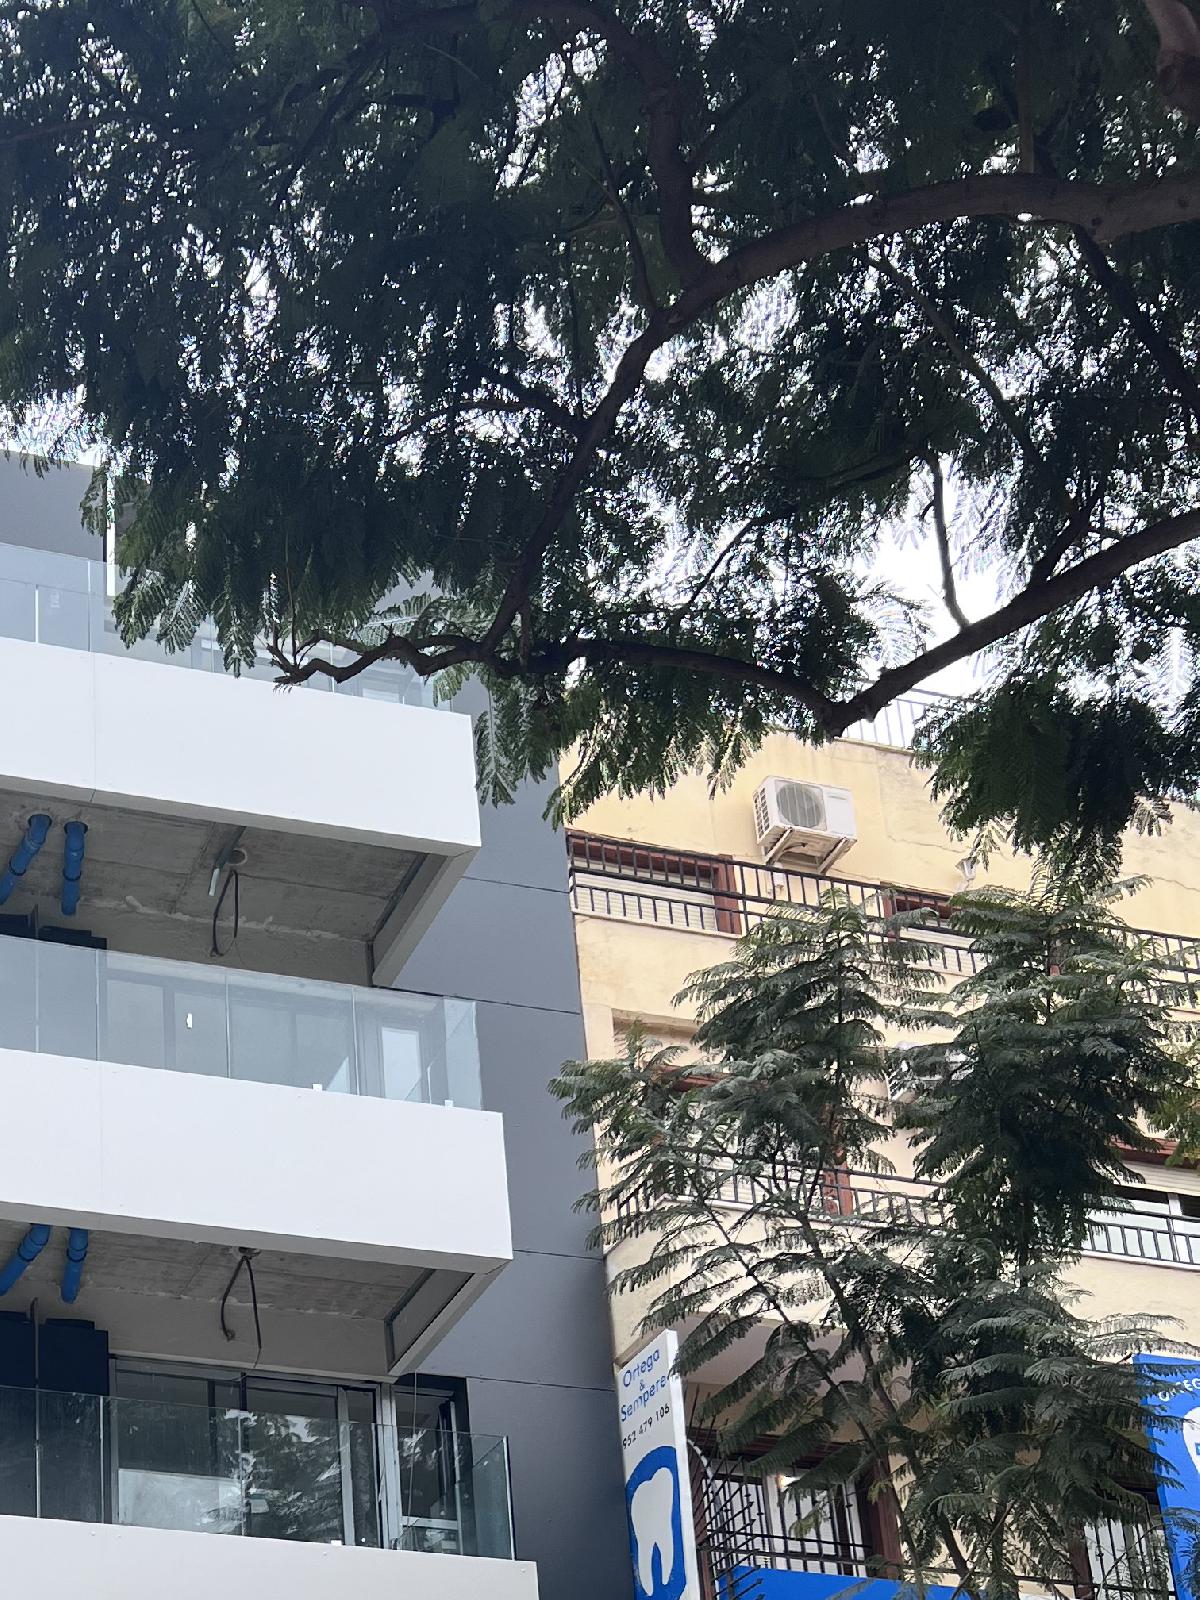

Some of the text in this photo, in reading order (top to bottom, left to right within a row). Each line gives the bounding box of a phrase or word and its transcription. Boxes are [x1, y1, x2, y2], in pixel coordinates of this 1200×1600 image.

[622, 1348, 661, 1388] Ortega
[622, 1430, 637, 1450] 952
[655, 1403, 670, 1421] 106
